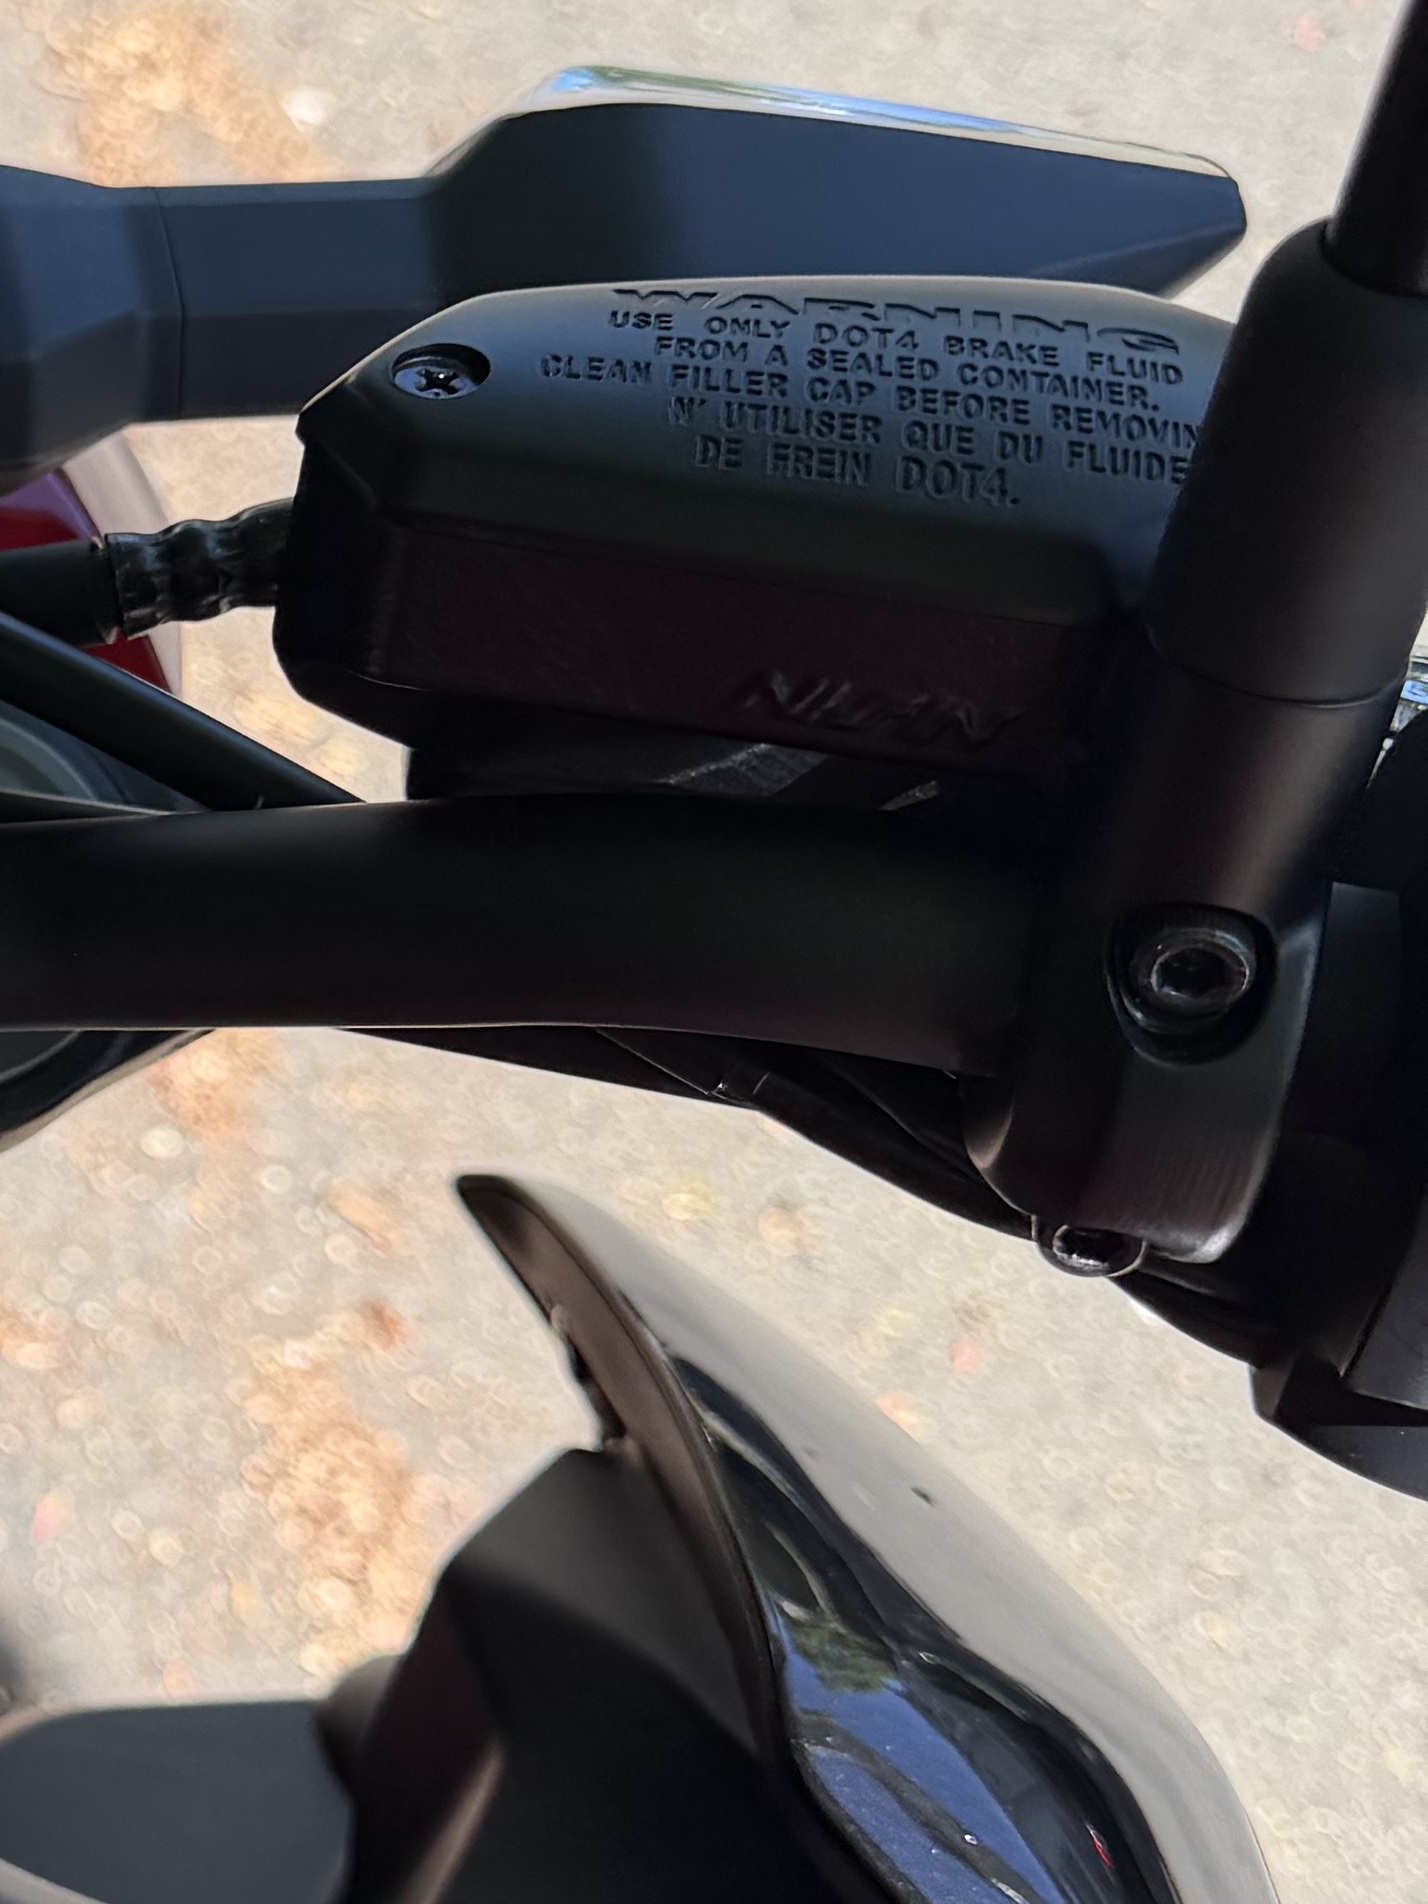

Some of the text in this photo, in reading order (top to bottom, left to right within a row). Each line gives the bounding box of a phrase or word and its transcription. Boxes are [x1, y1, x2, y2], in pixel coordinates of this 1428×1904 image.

[607, 309, 1184, 387] USE ONLY DOT4 BRAKE FLUID
[613, 288, 1180, 356] WARNING
[540, 352, 1201, 449] CLEAN FILLER CAP BEFORE REMOVIN
[655, 335, 1161, 413] FROM A SEALED CONTAINER.
[693, 432, 744, 472] DE
[766, 441, 874, 489] FREIN
[721, 400, 885, 447] UTILISER
[902, 419, 976, 457] QUE
[998, 430, 1044, 466] DU
